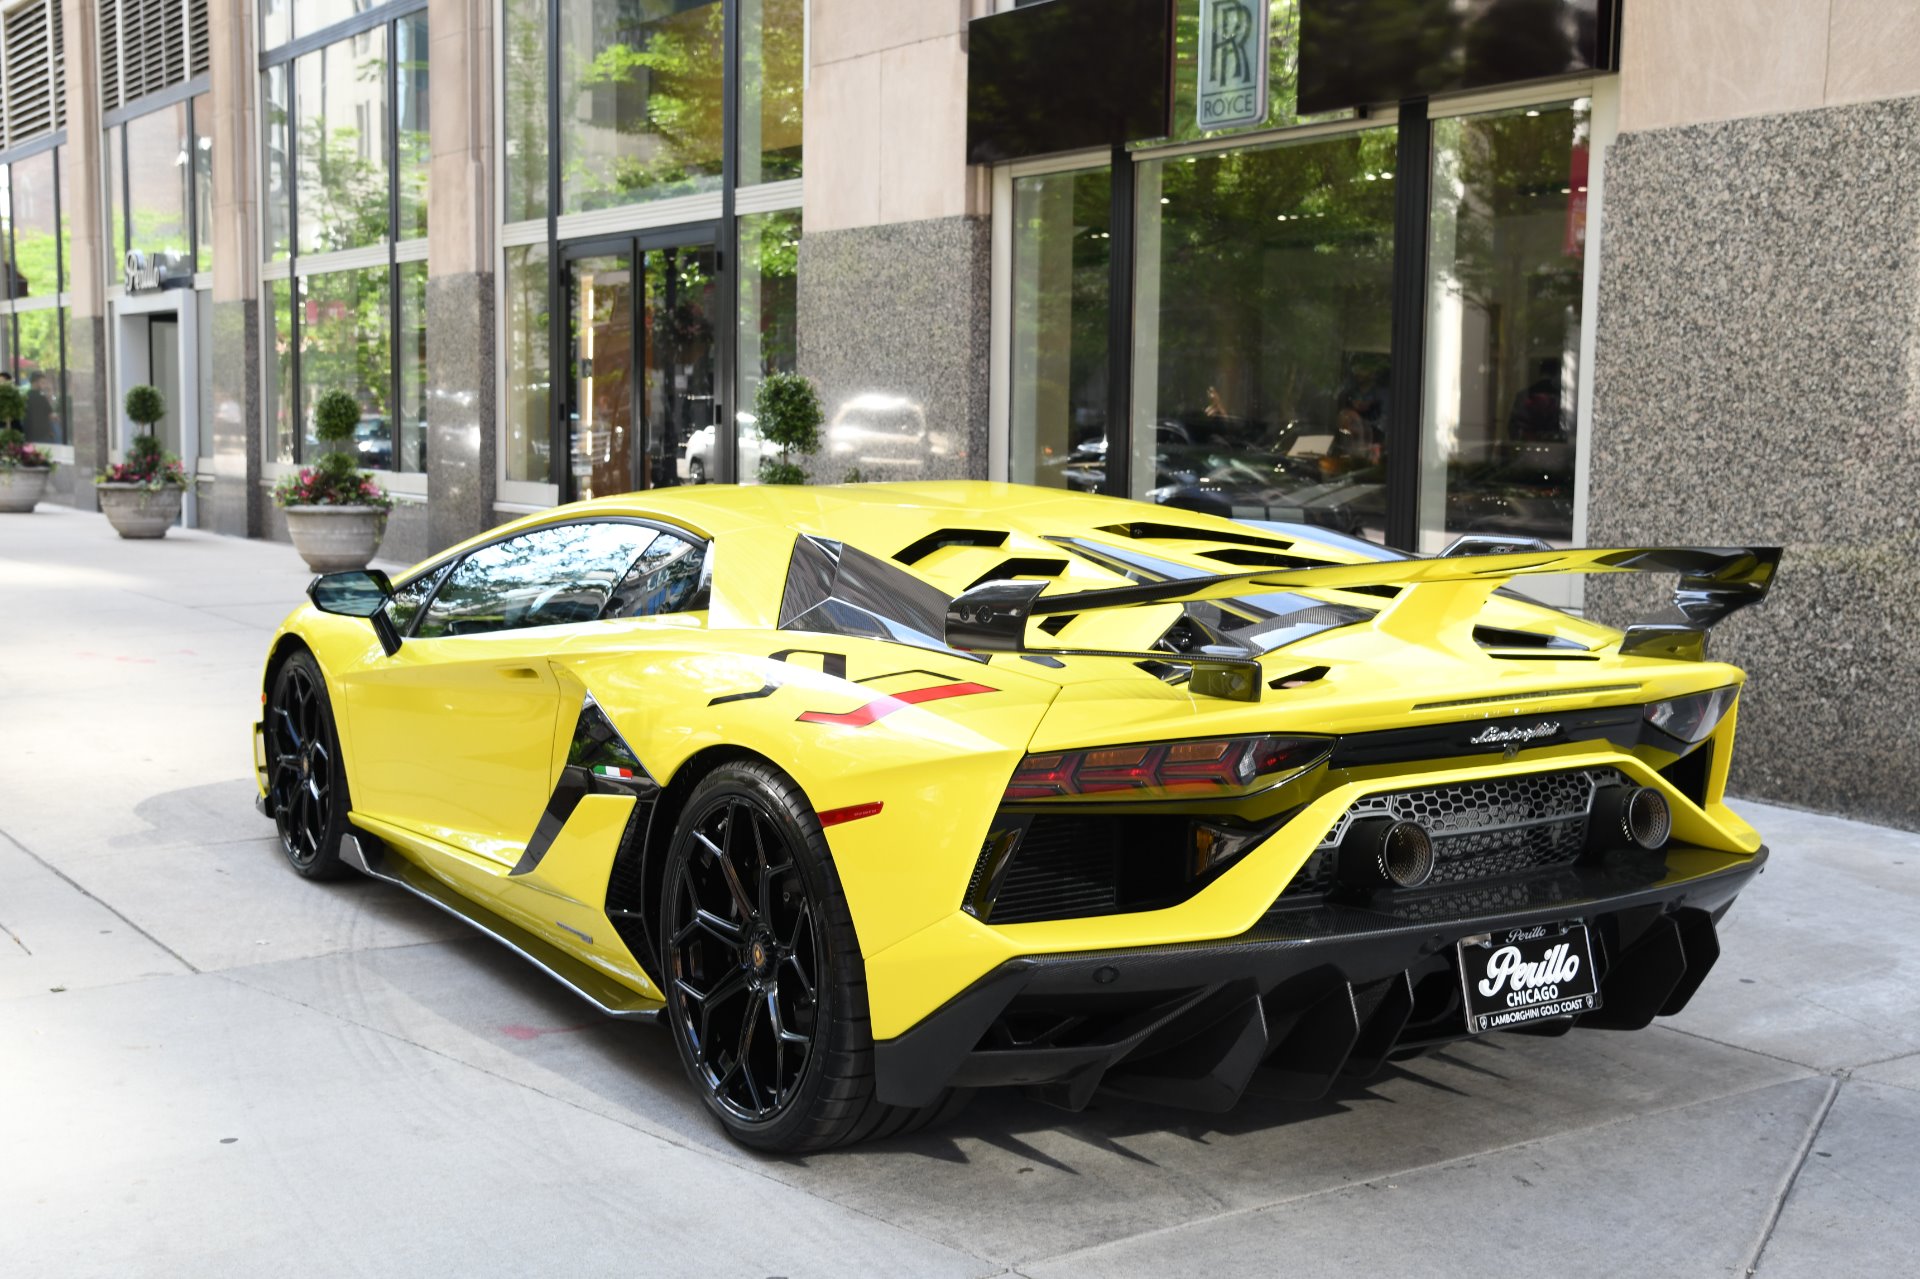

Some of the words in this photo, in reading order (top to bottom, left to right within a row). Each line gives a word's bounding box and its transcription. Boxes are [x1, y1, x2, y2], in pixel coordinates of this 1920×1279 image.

[1203, 93, 1253, 118] ROYCE
[1505, 926, 1546, 943] Perillo
[1478, 943, 1580, 997] Perillo
[1506, 985, 1559, 1007] CHICAGO
[1490, 1006, 1540, 1027] LAMBORGHINI
[1540, 1003, 1560, 1017] GOLD
[1560, 999, 1583, 1012] COAST
